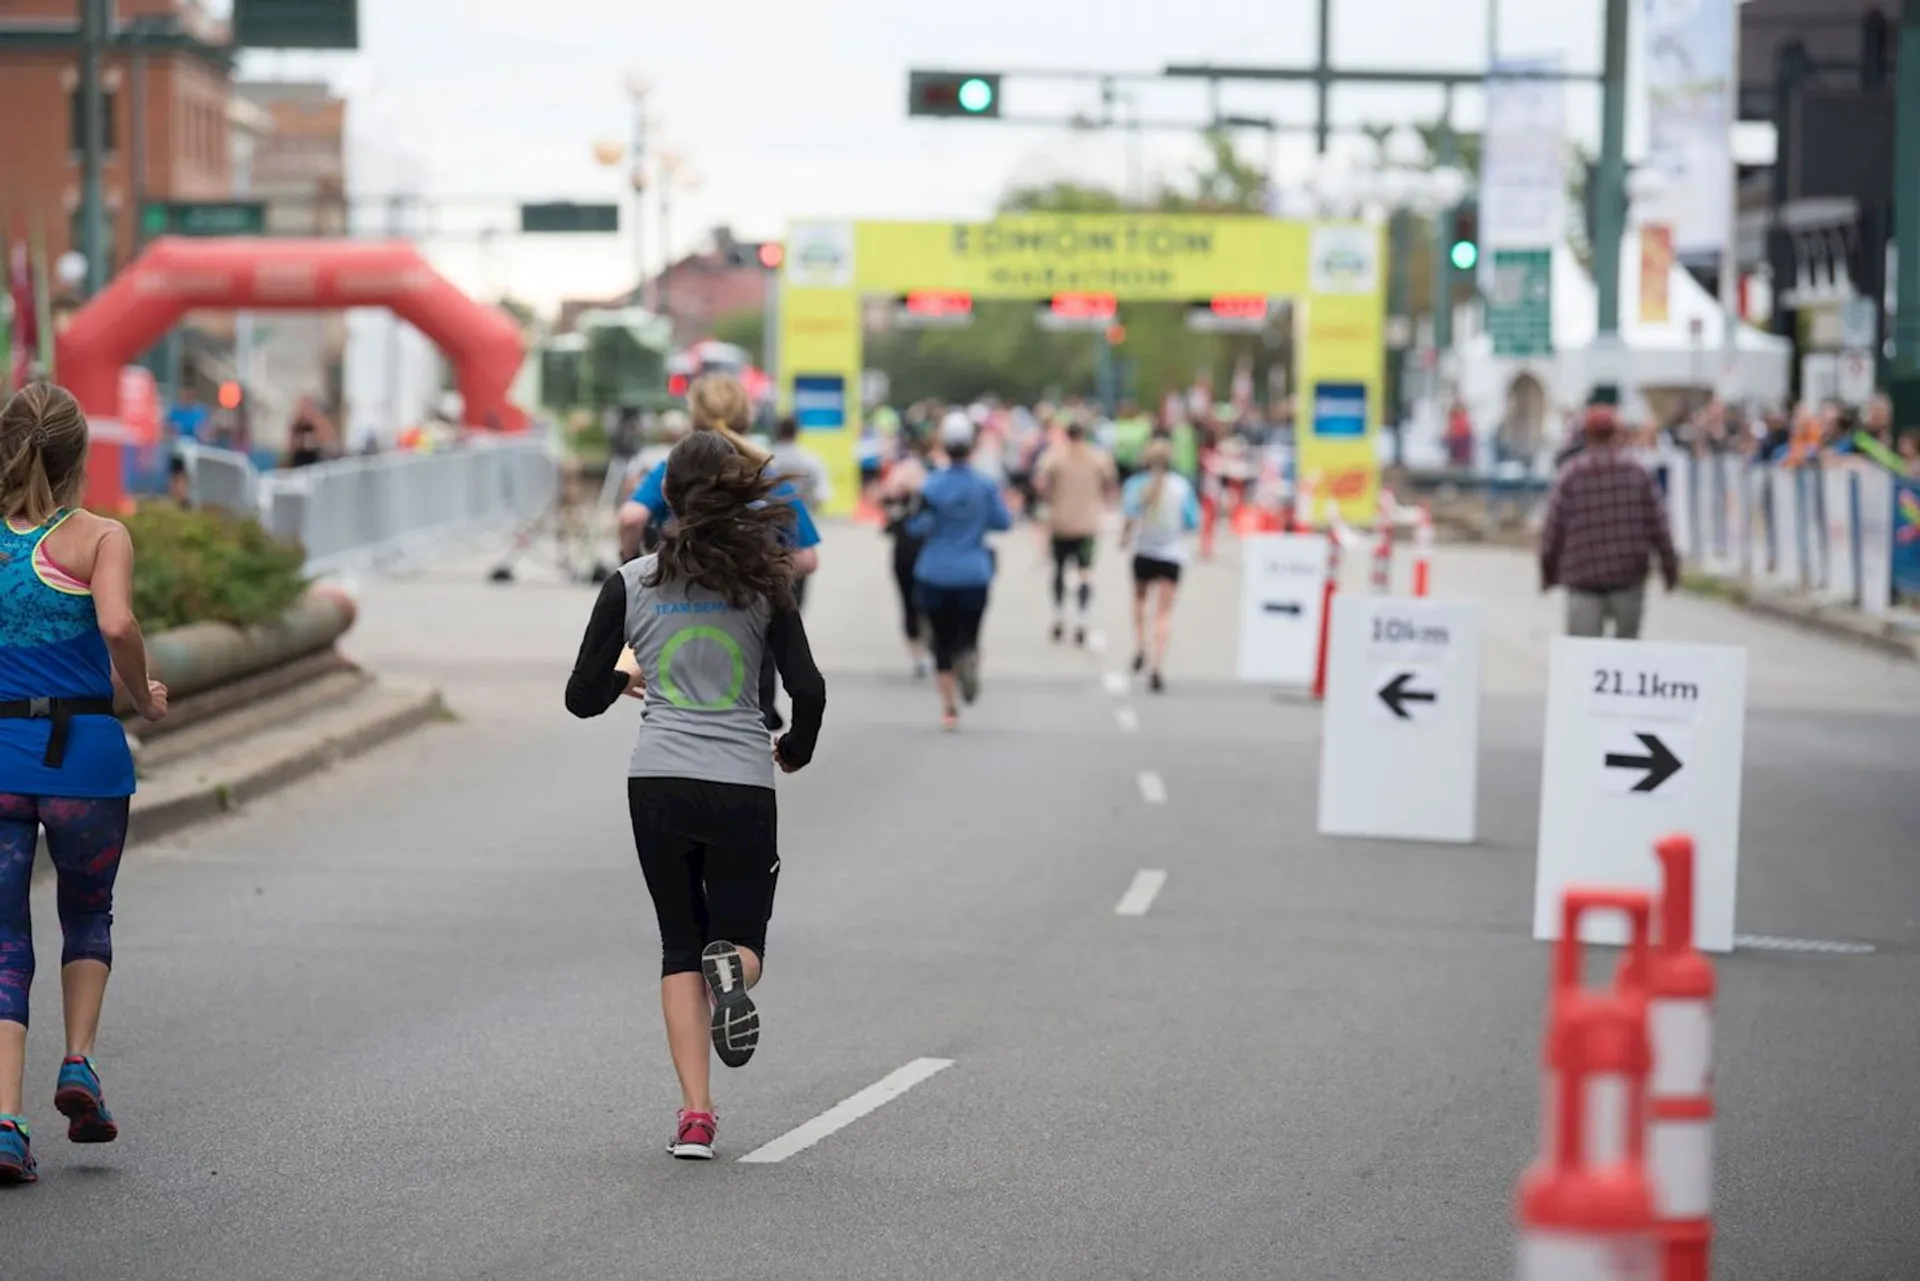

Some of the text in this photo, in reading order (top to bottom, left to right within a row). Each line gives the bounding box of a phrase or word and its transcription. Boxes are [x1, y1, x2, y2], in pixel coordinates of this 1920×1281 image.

[953, 222, 1213, 256] EDMONTON
[654, 602, 691, 616] TEAM
[1371, 616, 1450, 646] 10km
[1593, 668, 1699, 701] 21.1km
